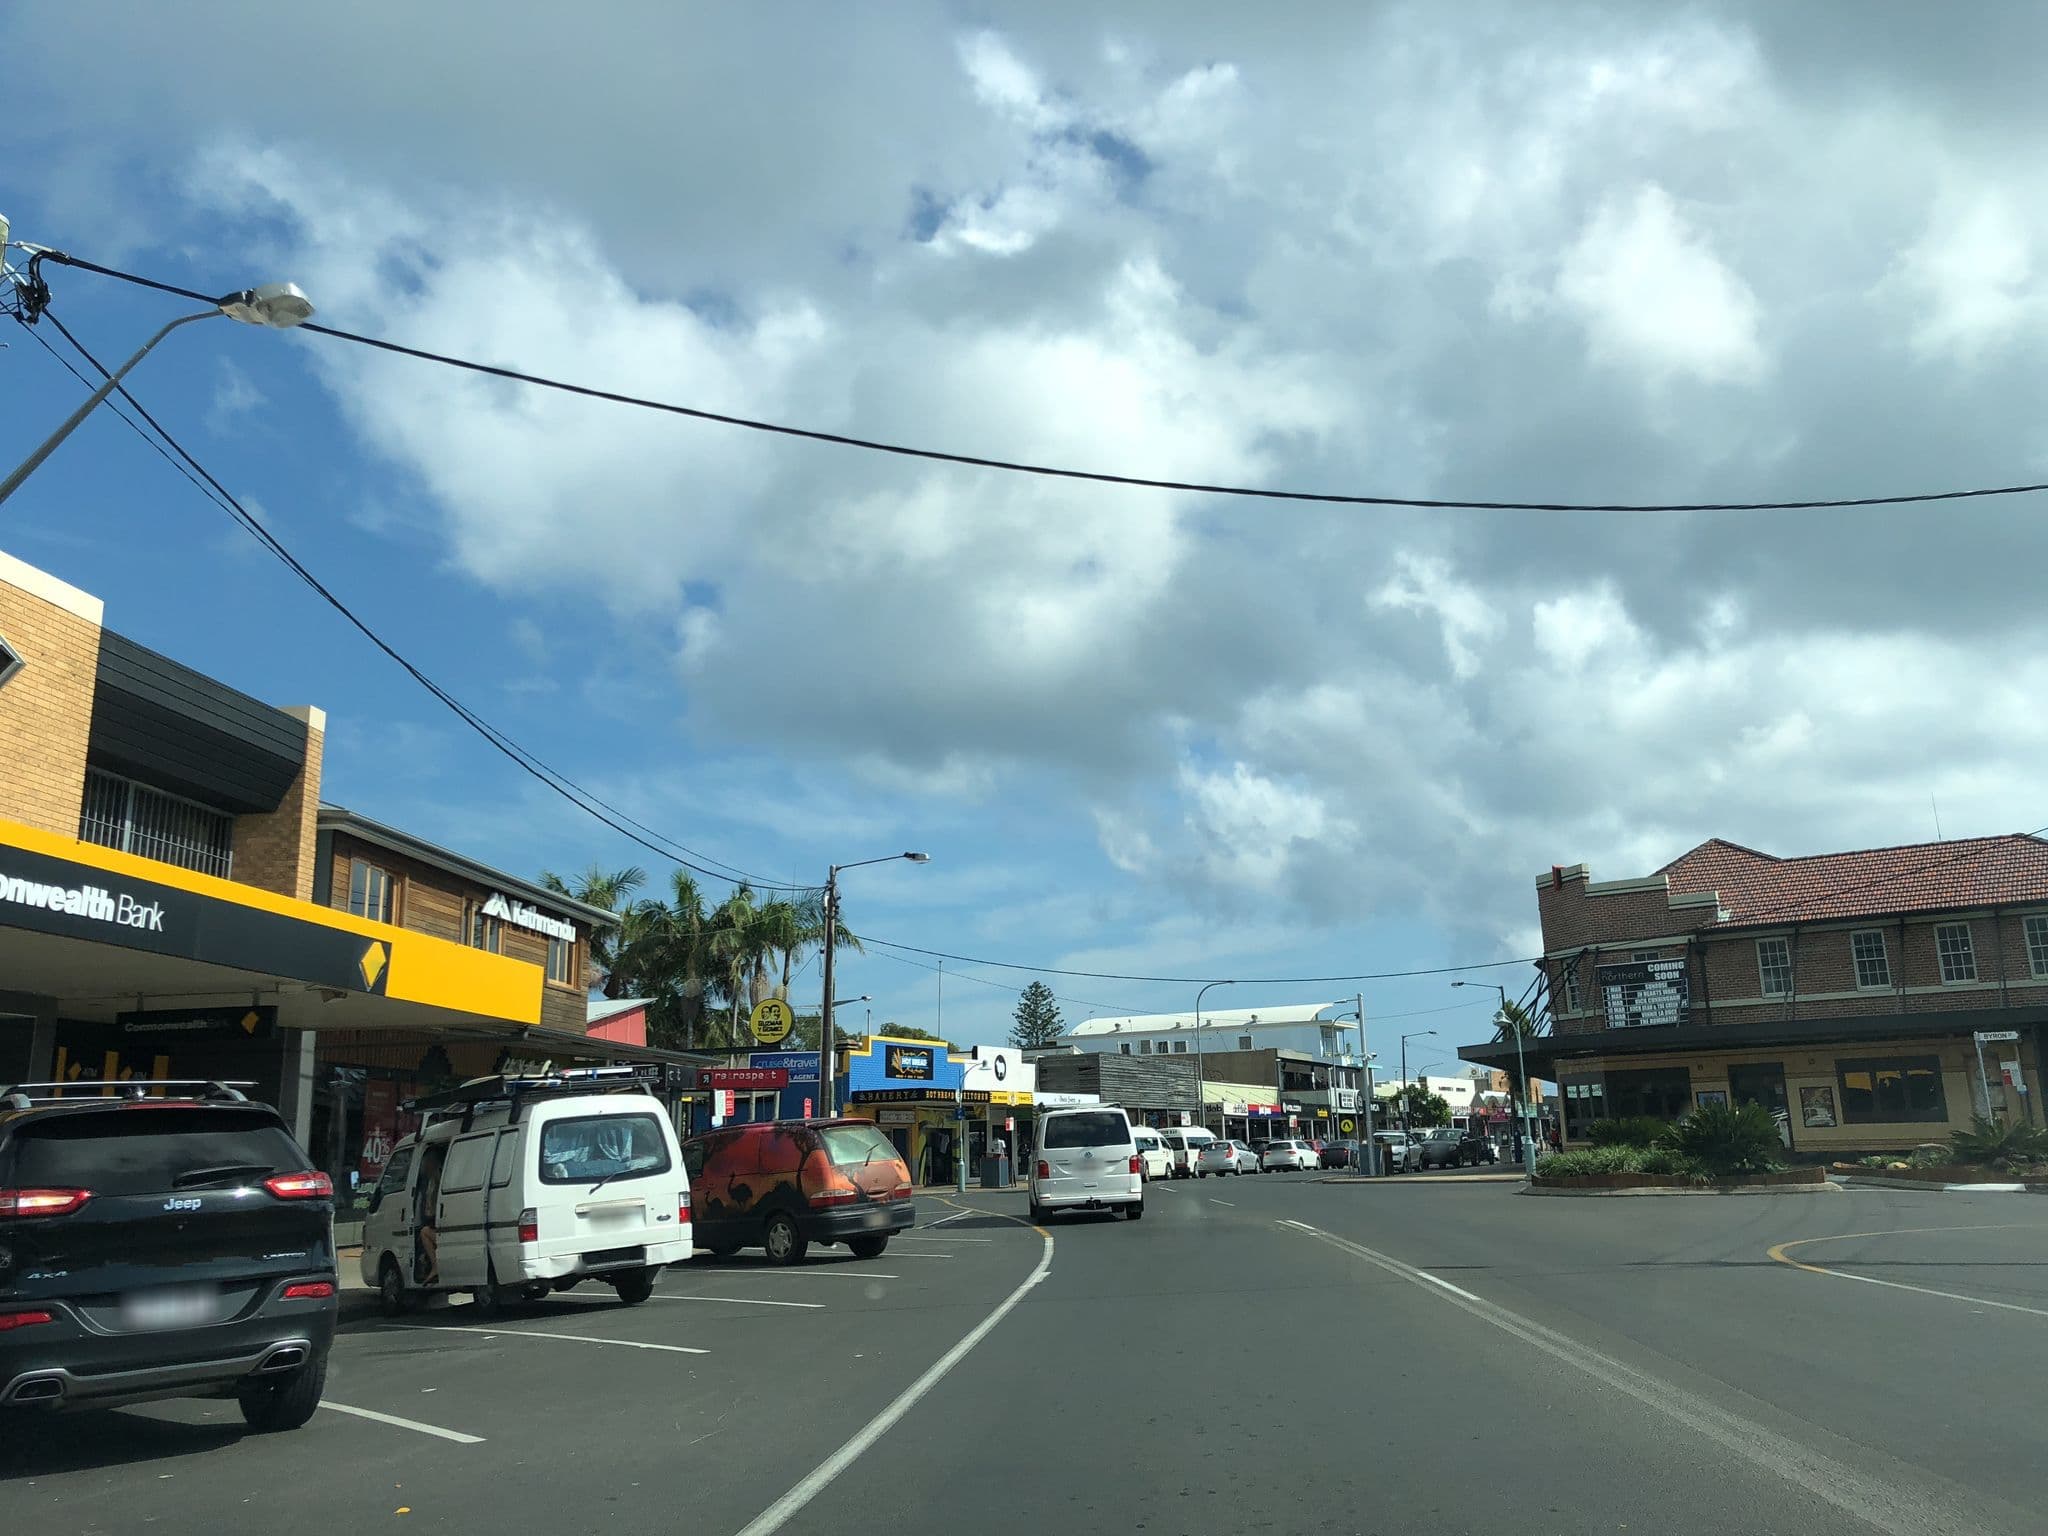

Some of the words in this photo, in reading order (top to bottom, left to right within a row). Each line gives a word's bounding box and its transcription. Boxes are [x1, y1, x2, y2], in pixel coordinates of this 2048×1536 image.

[116, 893, 165, 932] Bank
[1647, 961, 1684, 972] COMING
[1601, 970, 1644, 981] northern
[1654, 970, 1680, 981] SOON
[125, 1019, 208, 1033] Commonwealth
[1983, 1032, 2007, 1040] BYRON
[793, 1073, 815, 1081] AGENT
[163, 1198, 202, 1211] Jeep
